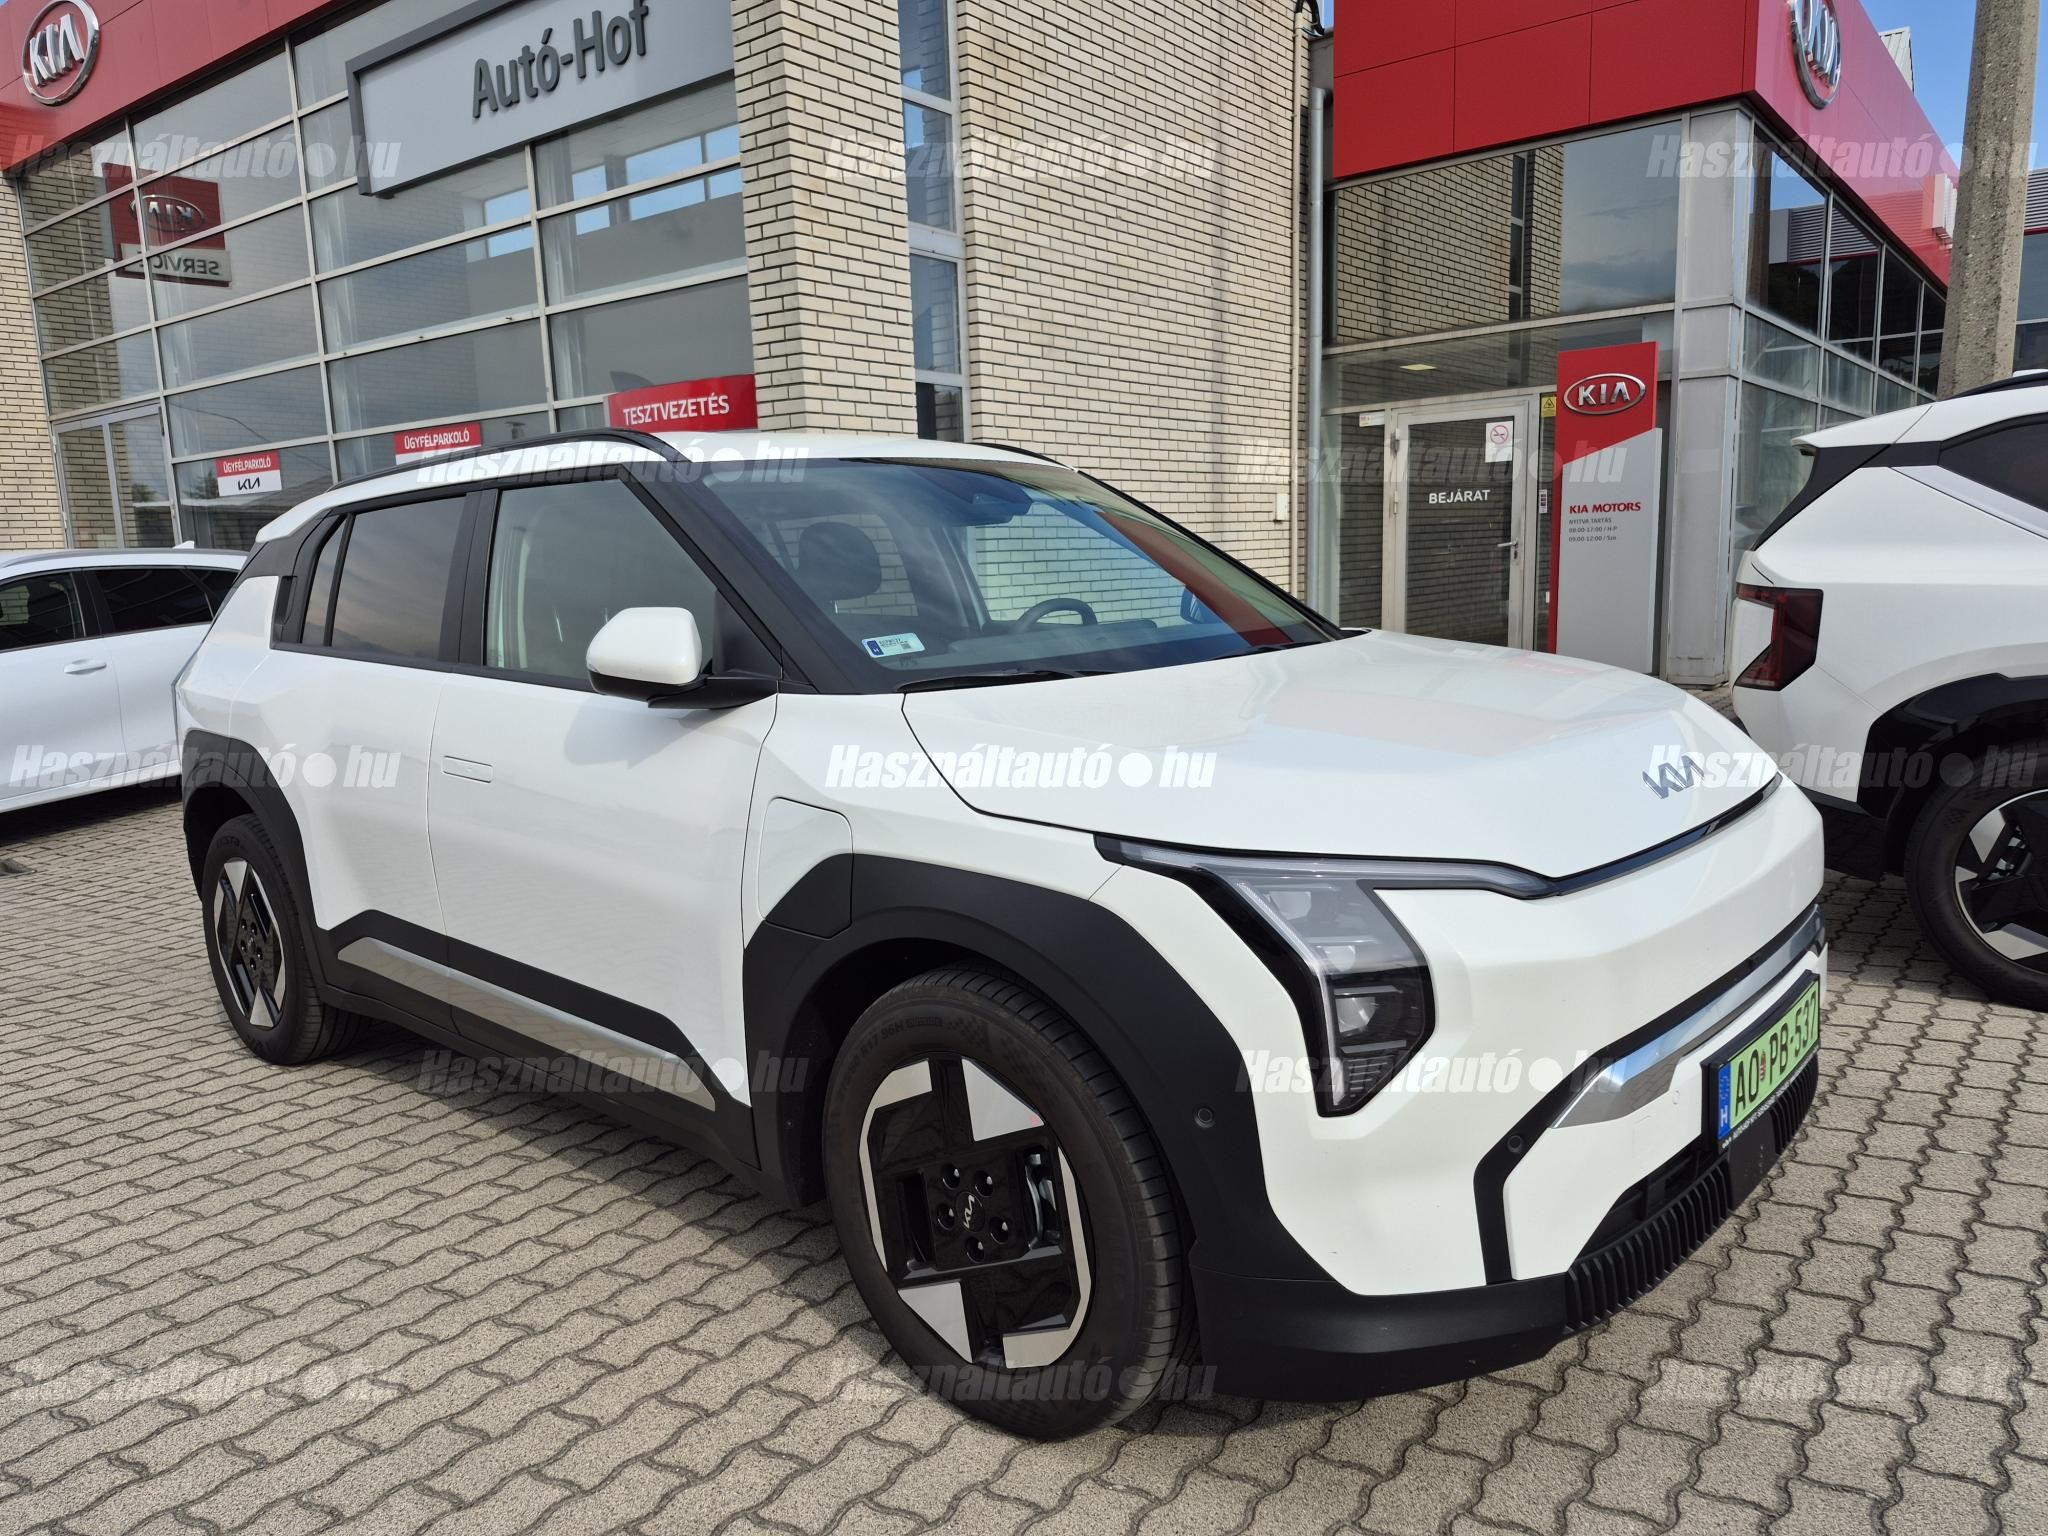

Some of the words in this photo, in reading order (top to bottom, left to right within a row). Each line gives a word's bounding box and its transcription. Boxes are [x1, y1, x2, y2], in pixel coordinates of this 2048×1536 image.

[29, 13, 85, 87] KIA
[473, 0, 650, 119] Autó-Hof
[1577, 381, 1631, 406] KIA
[622, 392, 730, 426] TESZTVEZETÉS
[403, 426, 470, 450] ÜGYFÉLPARKOLÓ
[223, 457, 272, 473] ÜGYFÉLPARKOLÓ
[1428, 488, 1491, 504] BEJÁRAT
[1569, 504, 1588, 514] KIA
[1592, 502, 1642, 513] MOTORS
